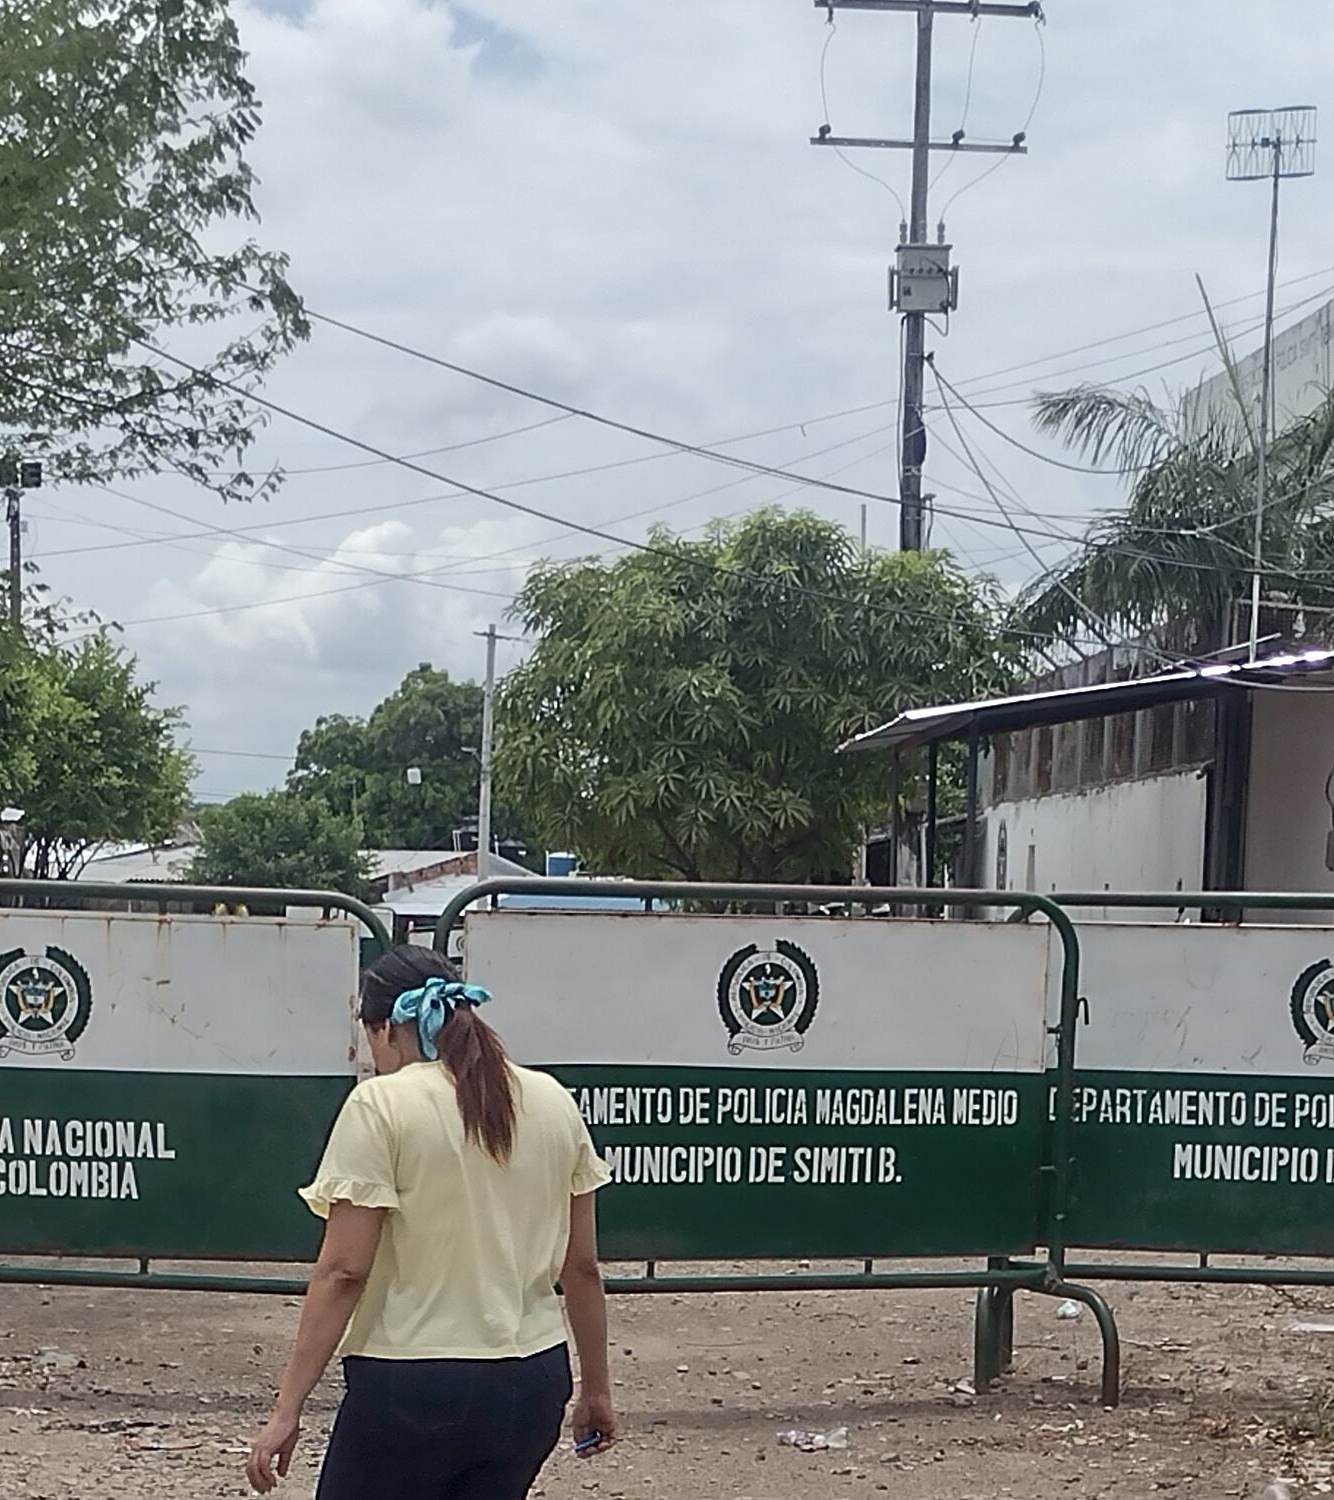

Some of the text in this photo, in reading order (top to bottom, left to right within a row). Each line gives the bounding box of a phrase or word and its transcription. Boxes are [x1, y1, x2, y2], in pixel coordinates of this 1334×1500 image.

[680, 1088, 710, 1123] DE
[718, 1088, 806, 1124] POLICIA
[816, 1089, 945, 1124] MAGDALENA
[953, 1089, 1017, 1125] MEDIO
[1255, 1093, 1286, 1127] DE
[23, 1119, 176, 1160] NACIONAL
[604, 1146, 741, 1184] MUNICIPIO
[749, 1147, 786, 1182] DE
[793, 1147, 873, 1183] SIMITI
[1174, 1144, 1318, 1182] MUNICIPIO
